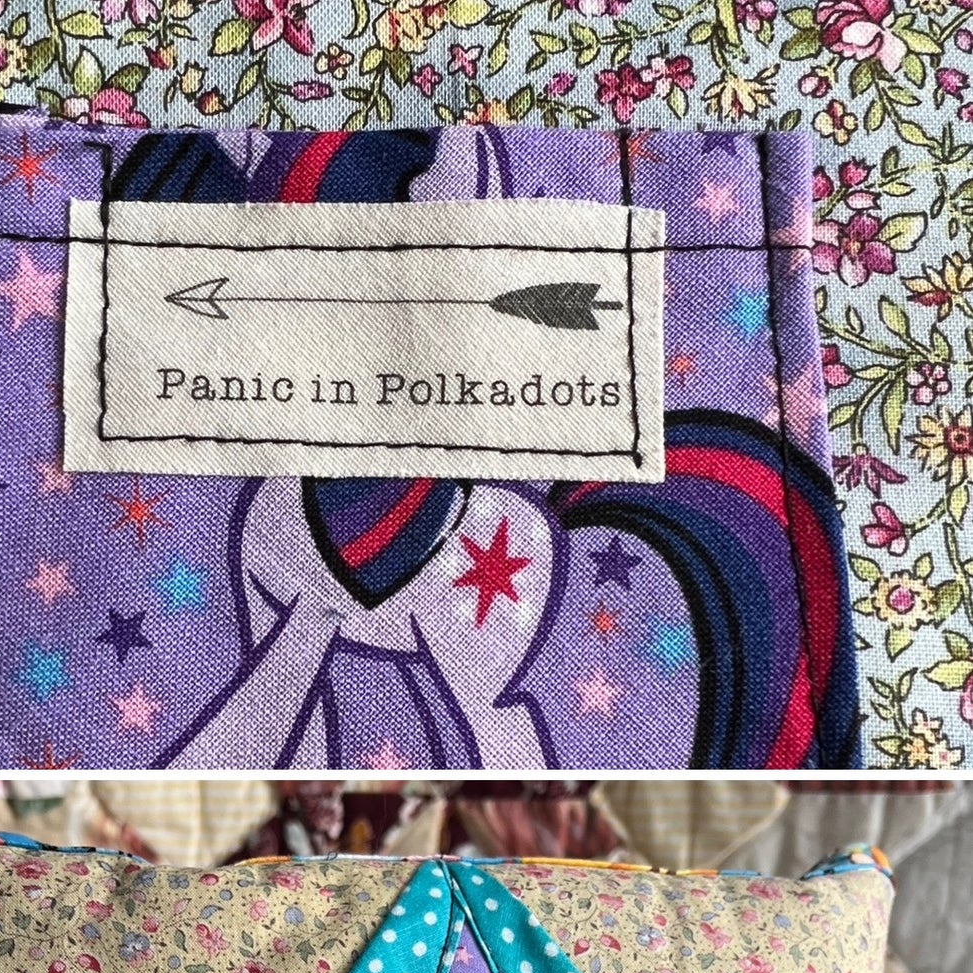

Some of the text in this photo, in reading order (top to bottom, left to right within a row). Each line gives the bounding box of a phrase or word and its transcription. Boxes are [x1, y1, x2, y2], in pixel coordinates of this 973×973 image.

[156, 367, 621, 408] Panic in Polkadots
